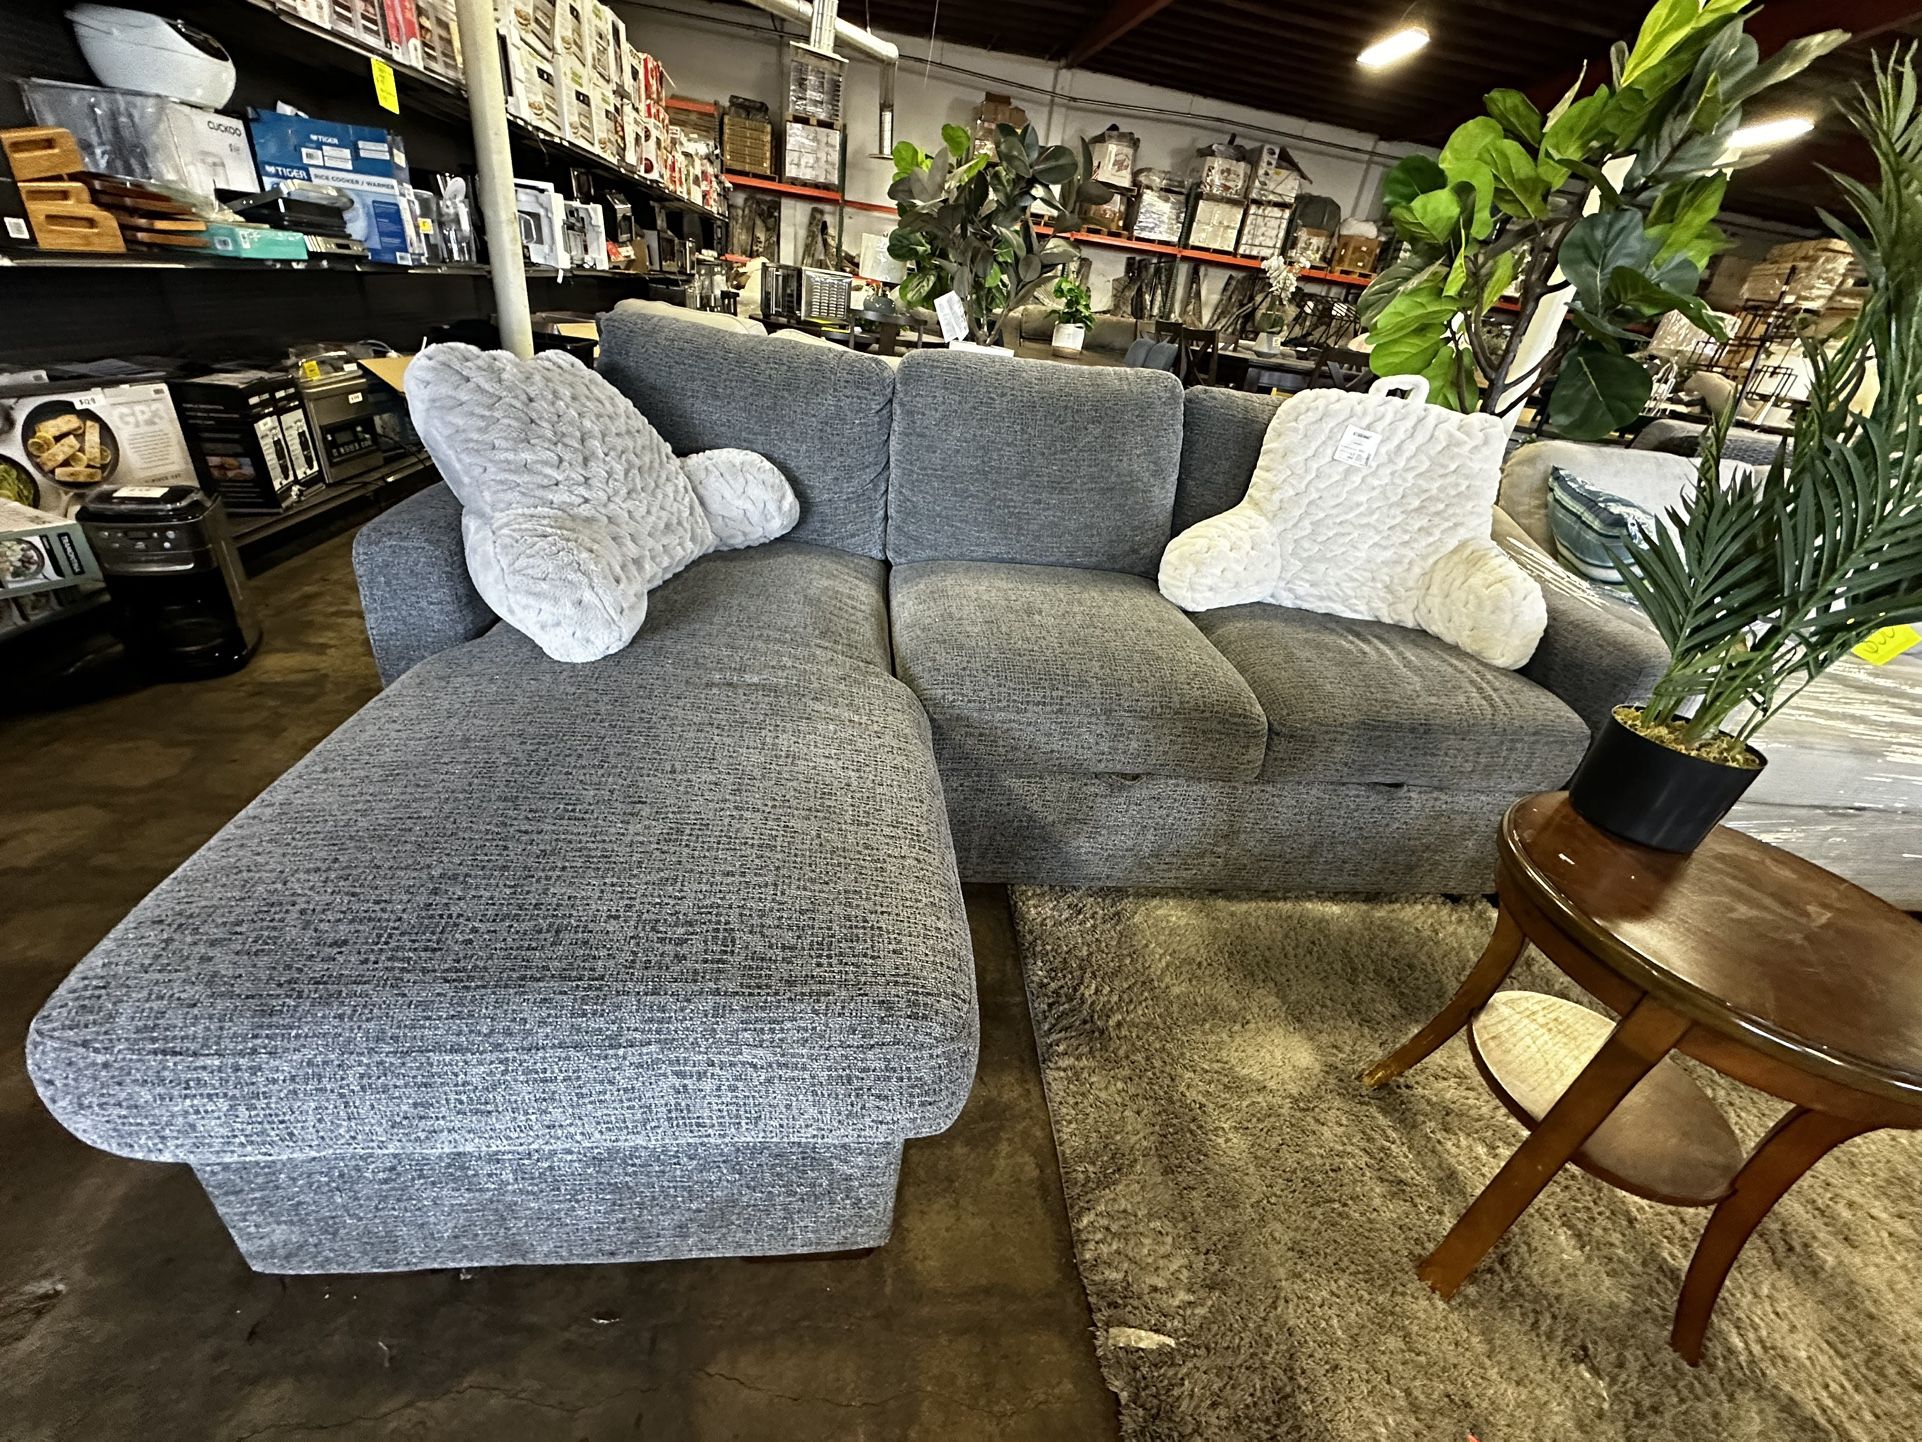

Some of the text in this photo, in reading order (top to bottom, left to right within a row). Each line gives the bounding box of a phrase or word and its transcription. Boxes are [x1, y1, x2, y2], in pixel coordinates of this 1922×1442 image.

[207, 121, 242, 137] CUCKOO
[317, 135, 339, 145] TIGER
[275, 167, 308, 180] TIGER
[313, 173, 330, 181] RICE
[331, 176, 360, 185] COOKER
[366, 181, 395, 190] WARMER
